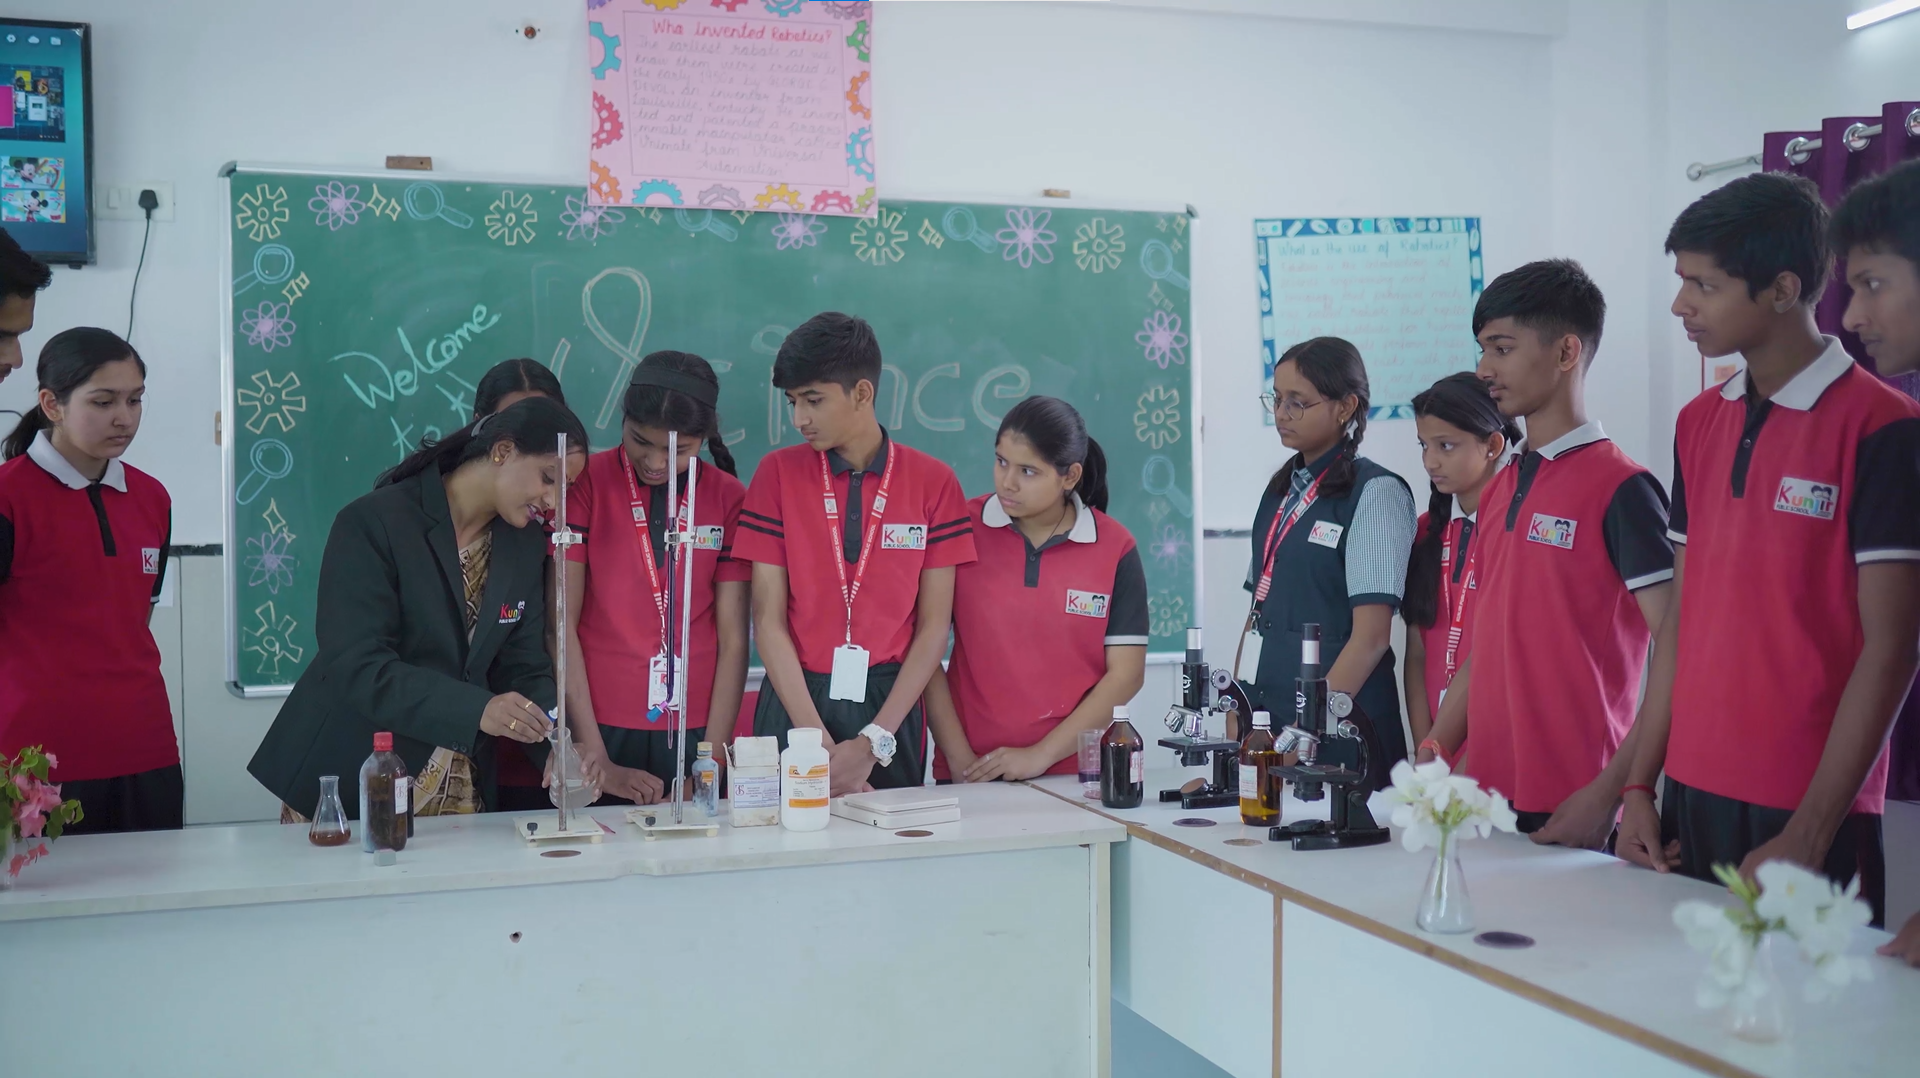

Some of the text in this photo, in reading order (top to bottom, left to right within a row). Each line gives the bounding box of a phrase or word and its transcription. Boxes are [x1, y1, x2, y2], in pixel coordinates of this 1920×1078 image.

[694, 20, 767, 39] Invented
[326, 302, 502, 410] Welcome
[1778, 484, 1835, 515] Kunjir
[884, 529, 925, 548] Kunjir
[1530, 519, 1572, 545] Kunjir
[1068, 594, 1107, 616] Kunjir
